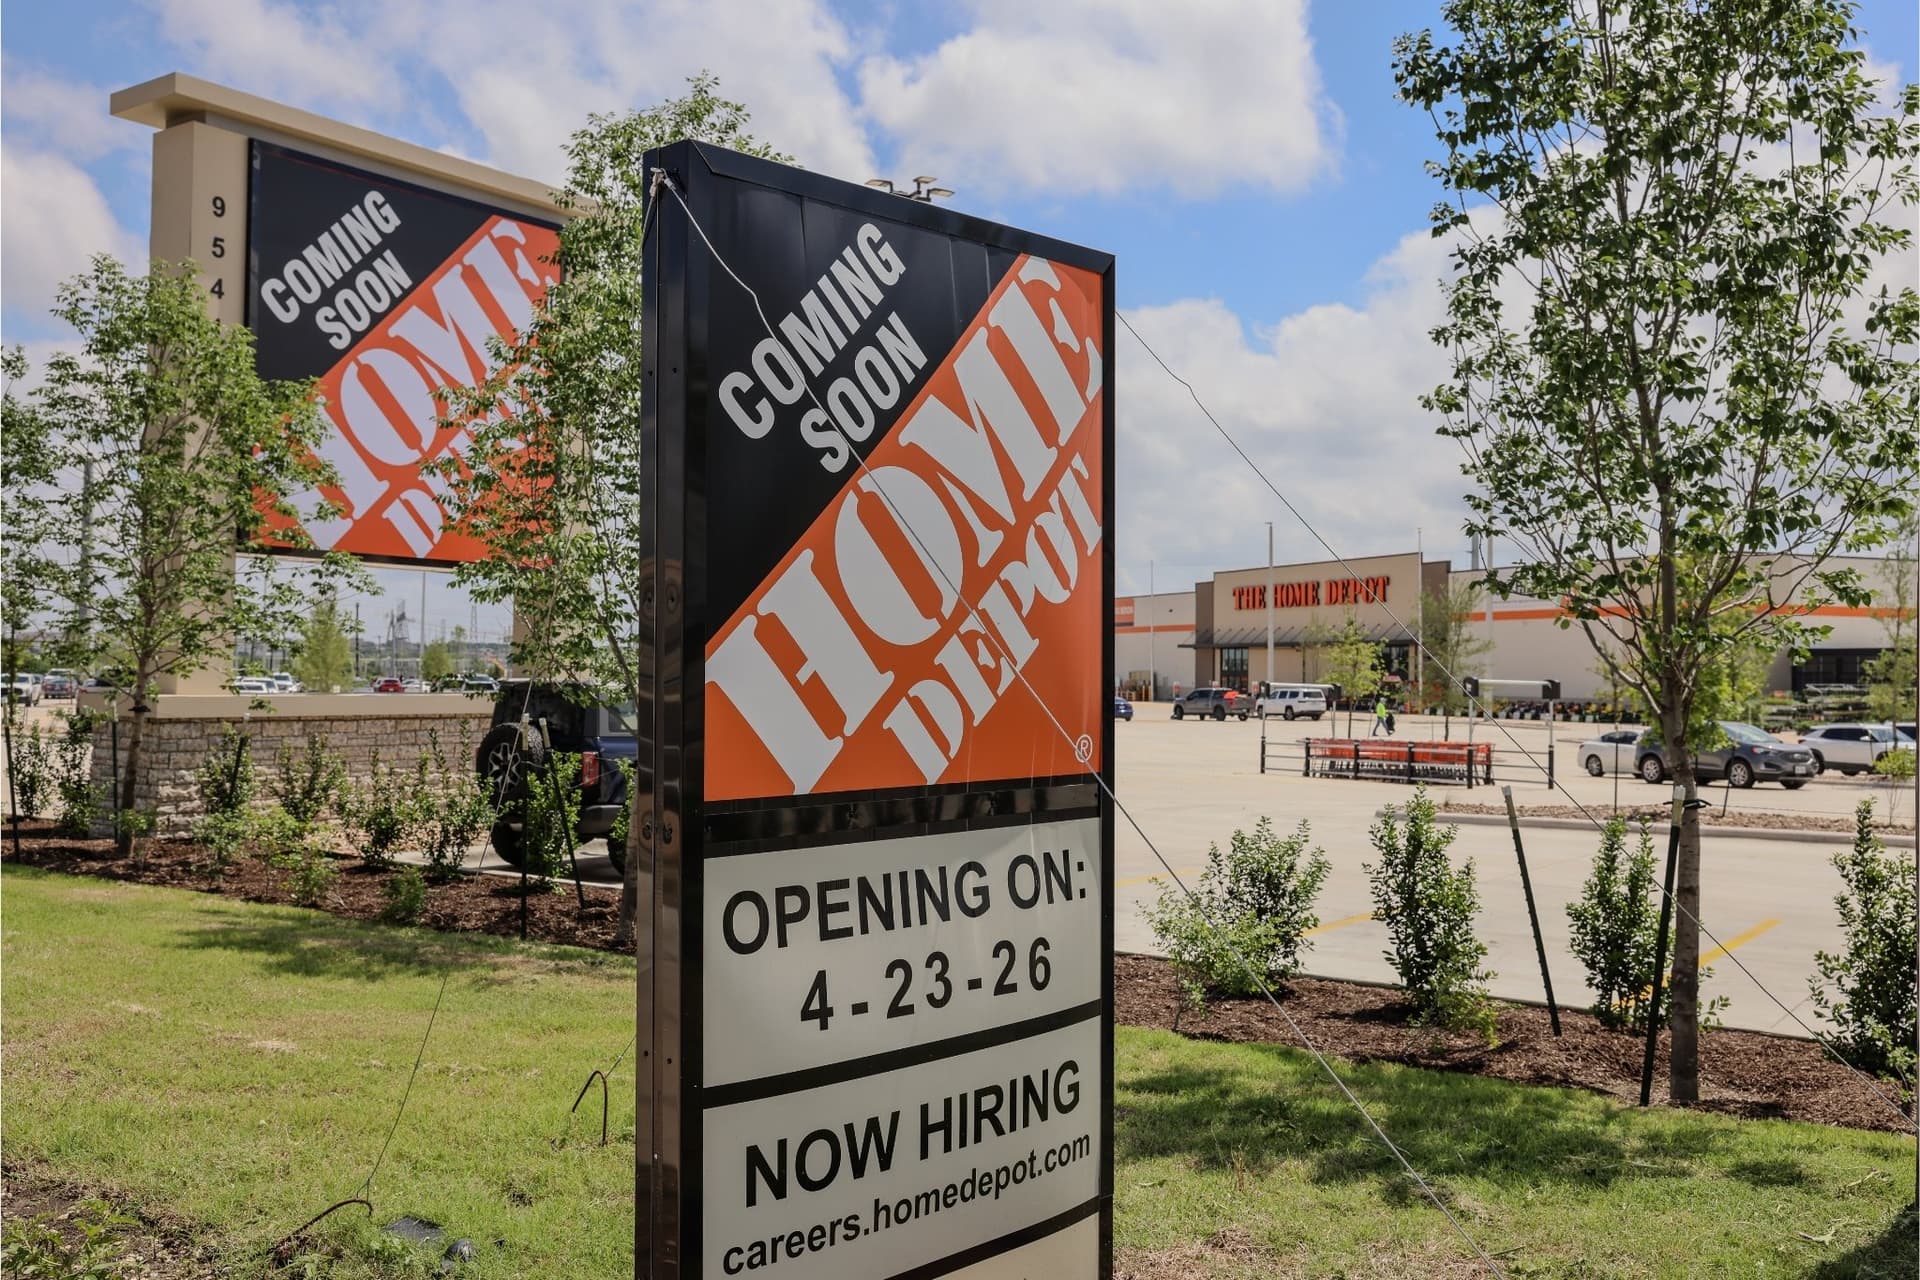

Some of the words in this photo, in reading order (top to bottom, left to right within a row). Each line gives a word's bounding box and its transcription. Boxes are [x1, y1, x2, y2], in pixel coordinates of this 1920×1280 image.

[260, 190, 402, 324] COMING
[315, 249, 413, 351] SOON
[718, 222, 907, 440] COMING
[800, 311, 929, 474] SOON
[704, 255, 1103, 796] HOME
[1232, 585, 1267, 611] THE
[1273, 580, 1320, 609] HOME
[1323, 575, 1391, 606] DEPOT
[883, 452, 1103, 786] DEPOT
[722, 861, 990, 955] OPENING
[1007, 849, 1088, 910] ON:
[722, 1133, 1090, 1276] careers.homedepot.com
[745, 1110, 900, 1208] NOW
[919, 1059, 1081, 1161] HIRING
